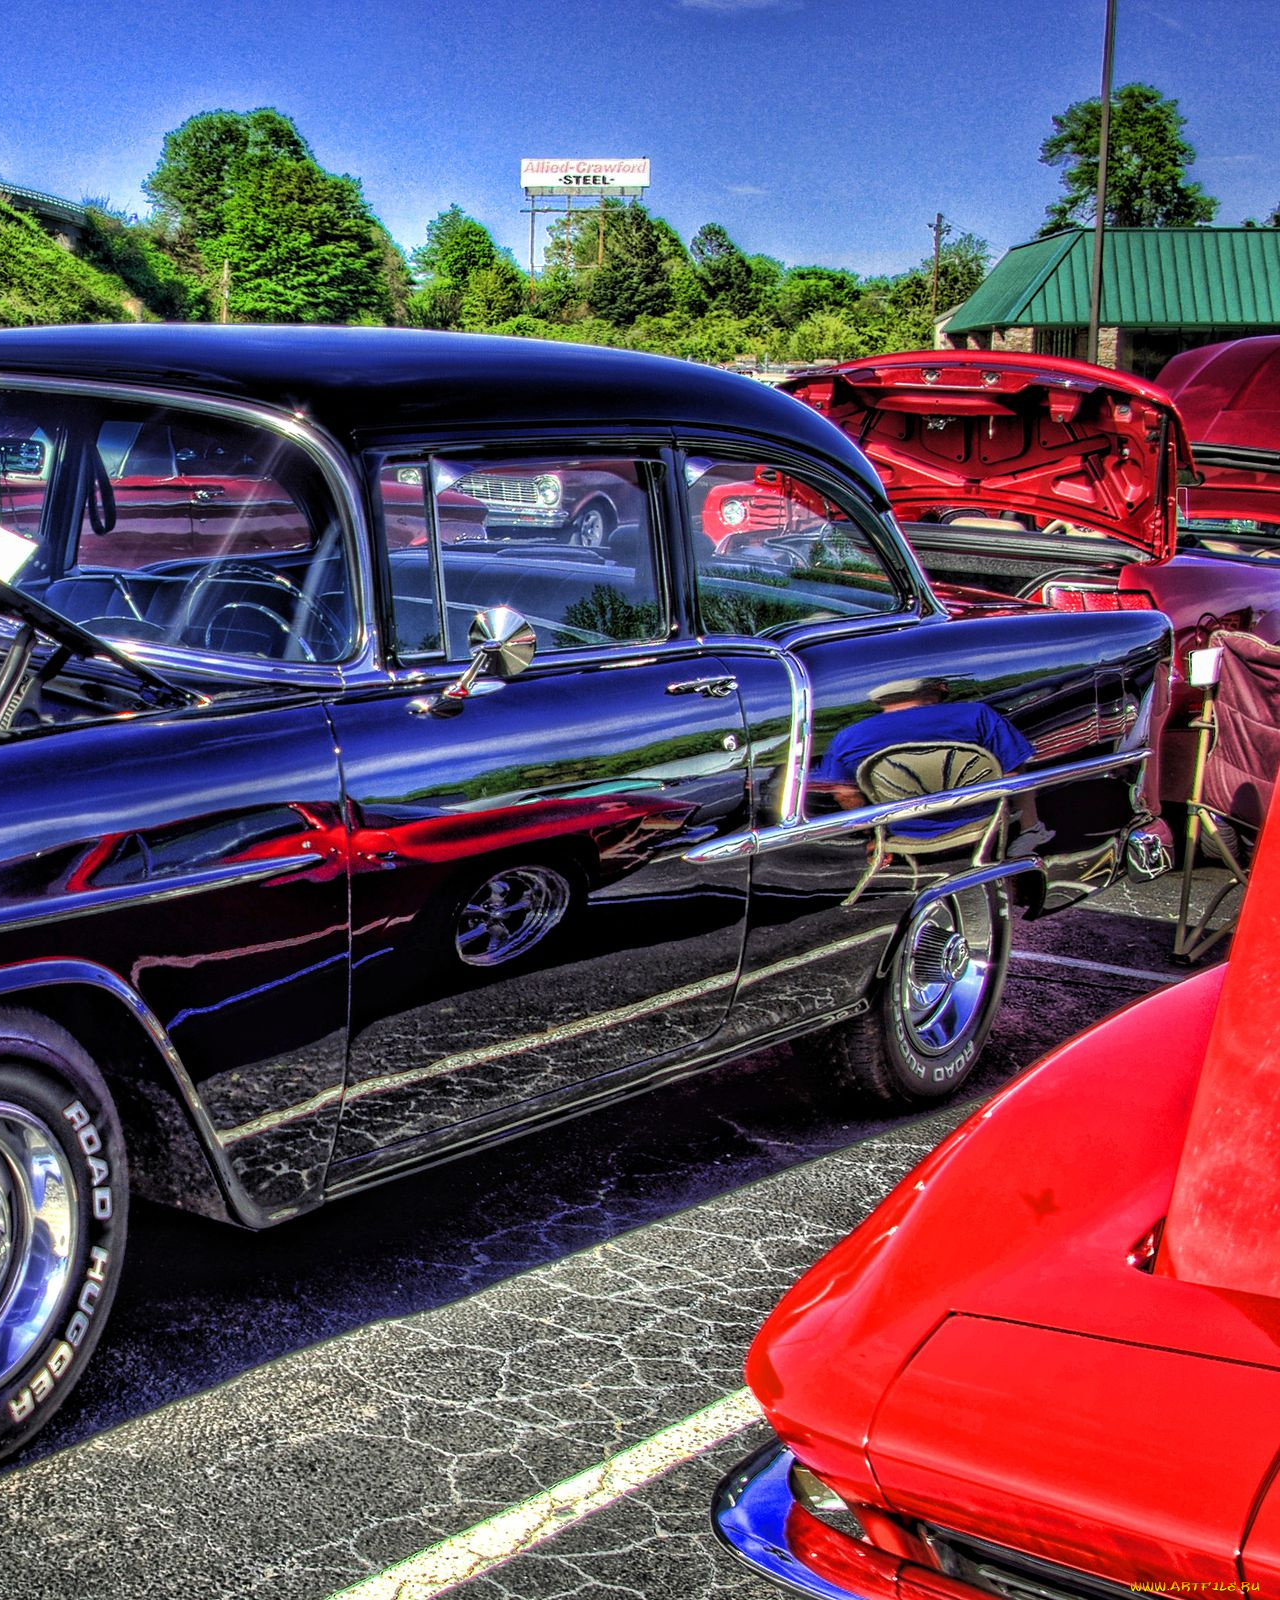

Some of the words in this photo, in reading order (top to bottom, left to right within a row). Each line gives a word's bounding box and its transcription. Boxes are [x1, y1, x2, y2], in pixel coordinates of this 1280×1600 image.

[523, 160, 648, 174] Allied-Crawford
[933, 1039, 975, 1082] ROAD
[62, 1099, 114, 1221] ROAD
[7, 1245, 111, 1423] HUGGER
